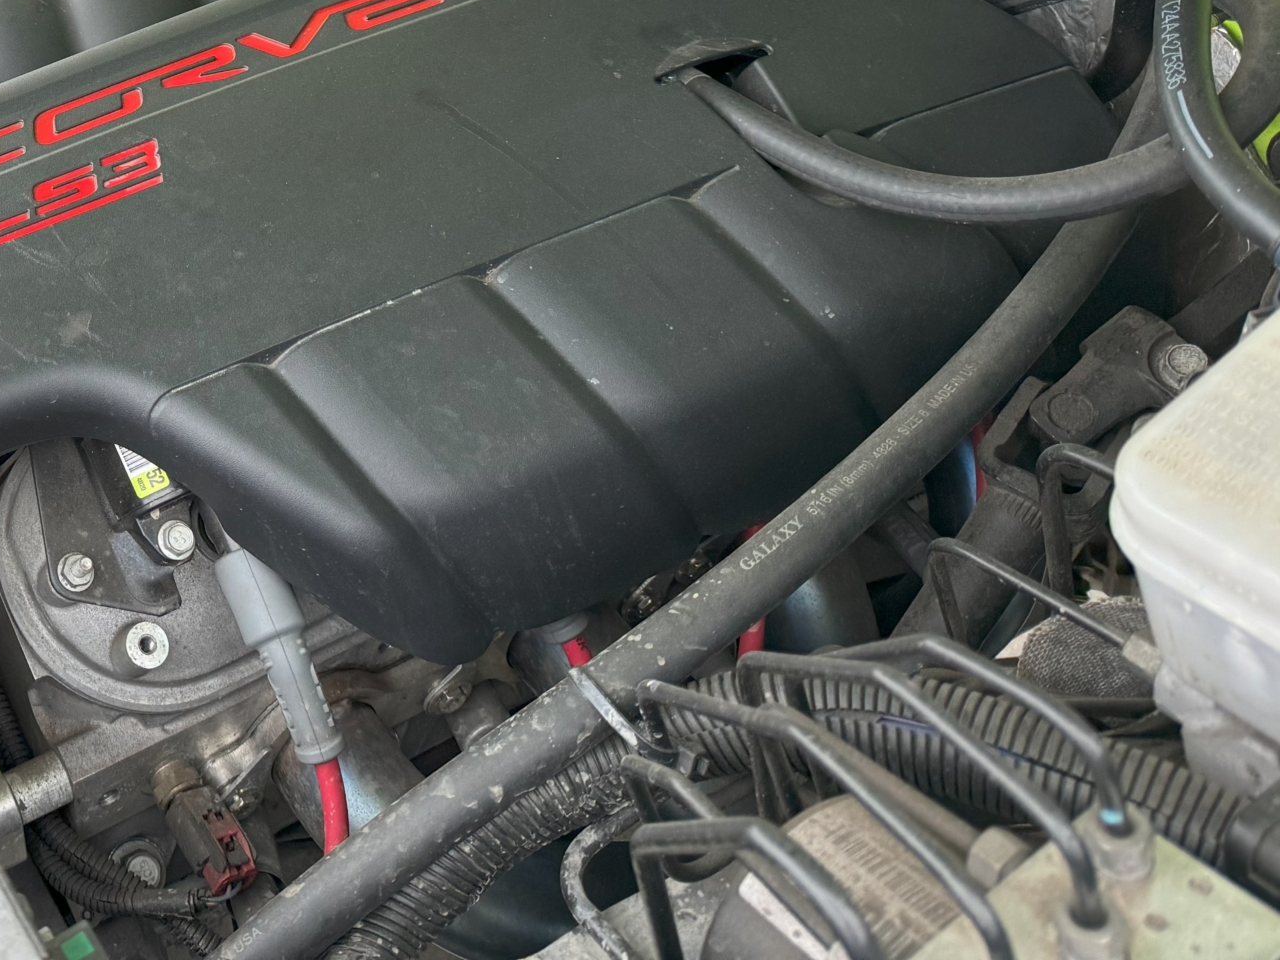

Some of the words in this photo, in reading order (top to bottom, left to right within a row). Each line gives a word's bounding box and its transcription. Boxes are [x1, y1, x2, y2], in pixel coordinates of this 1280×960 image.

[146, 467, 166, 488] 52
[739, 515, 804, 571] GALAXY
[826, 484, 845, 501] IN
[897, 414, 924, 436] SIZE
[926, 384, 957, 410] MADE
[233, 926, 263, 954] USA
